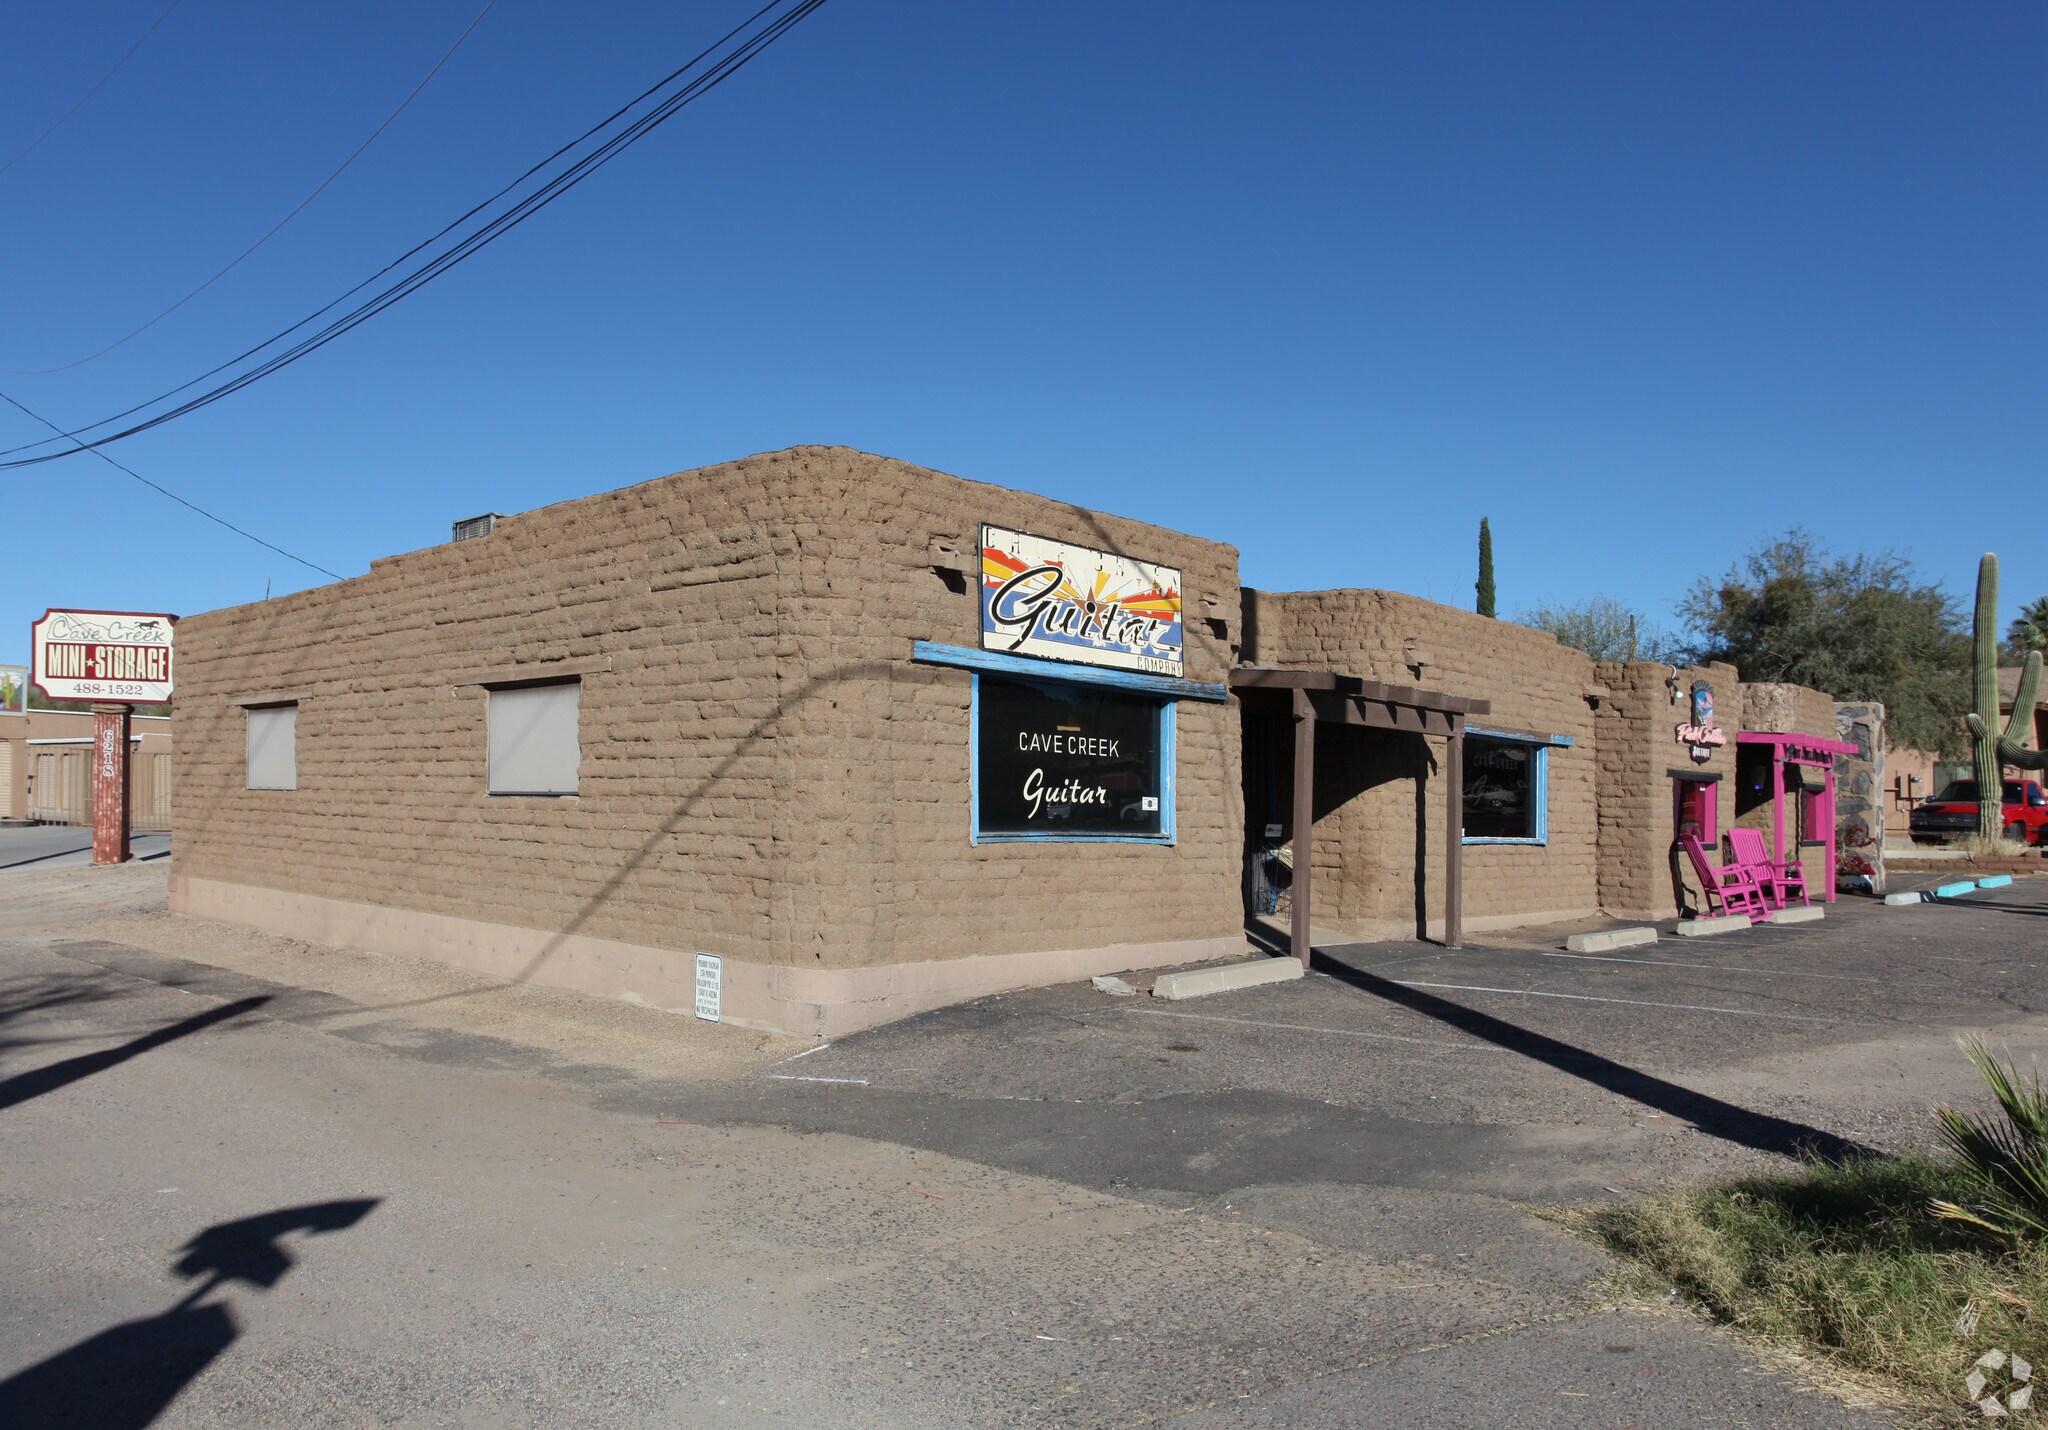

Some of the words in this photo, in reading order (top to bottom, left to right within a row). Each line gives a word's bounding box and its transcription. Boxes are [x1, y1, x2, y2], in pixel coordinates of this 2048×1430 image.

[989, 565, 1181, 651] Guitar
[53, 620, 100, 639] Cave
[108, 621, 165, 642] Creek
[48, 644, 86, 677] MINI
[95, 645, 166, 680] STORAGE
[73, 683, 144, 695] 488-1522
[103, 729, 114, 776] 6218
[1019, 731, 1063, 753] CAVE
[1067, 736, 1119, 758] CREEK
[1023, 767, 1107, 819] Guitar
